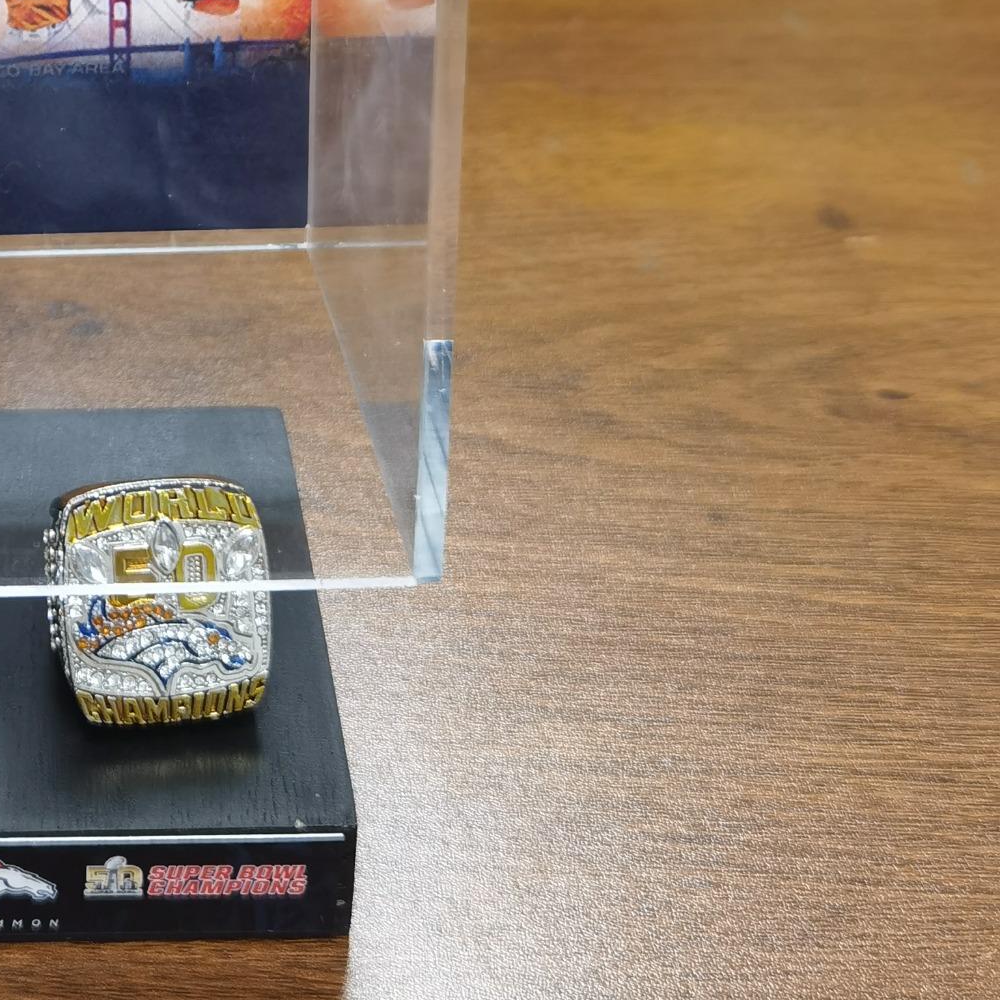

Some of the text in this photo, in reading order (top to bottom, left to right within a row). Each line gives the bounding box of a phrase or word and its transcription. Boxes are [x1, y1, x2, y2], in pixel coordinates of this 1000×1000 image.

[66, 486, 261, 544] WORLD
[75, 672, 268, 726] CHAMPIONS
[85, 864, 144, 892] 50
[148, 864, 308, 881] SUPER BOWL
[147, 879, 307, 896] CHAMPIONS
